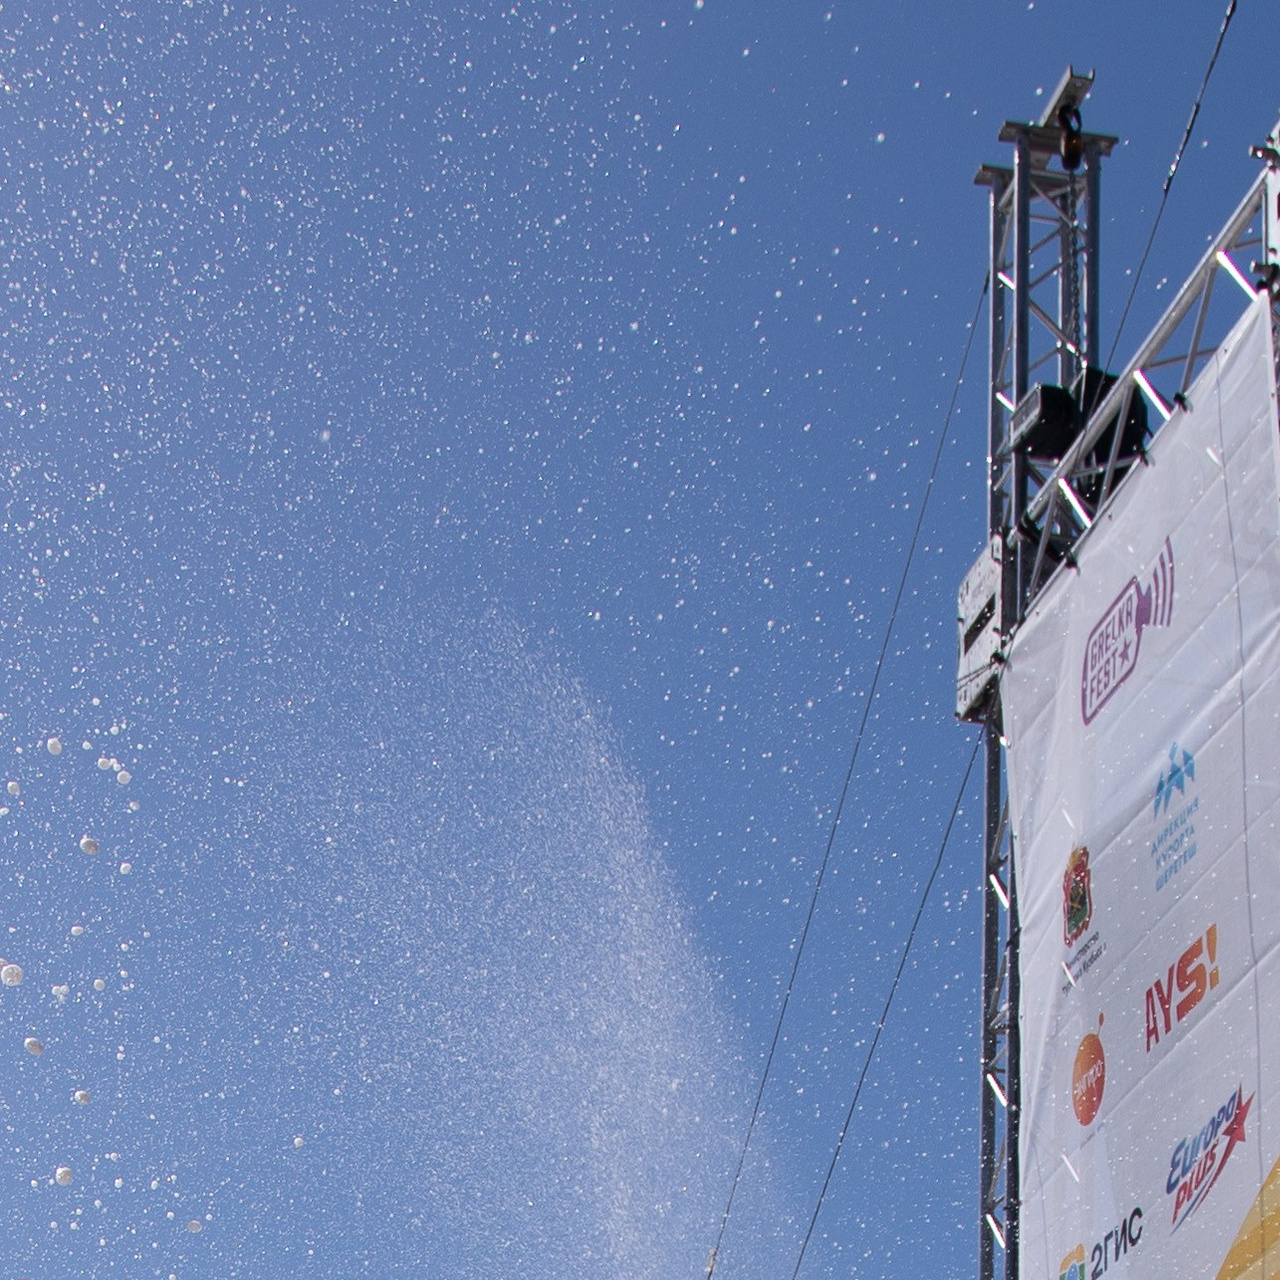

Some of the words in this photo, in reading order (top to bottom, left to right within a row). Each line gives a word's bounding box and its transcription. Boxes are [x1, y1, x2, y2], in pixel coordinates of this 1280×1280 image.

[1090, 594, 1133, 673] GRELKA
[1089, 647, 1118, 709] FEST
[1156, 842, 1197, 892] ШЕРЕГЕШ
[1144, 923, 1218, 1054] AYS!
